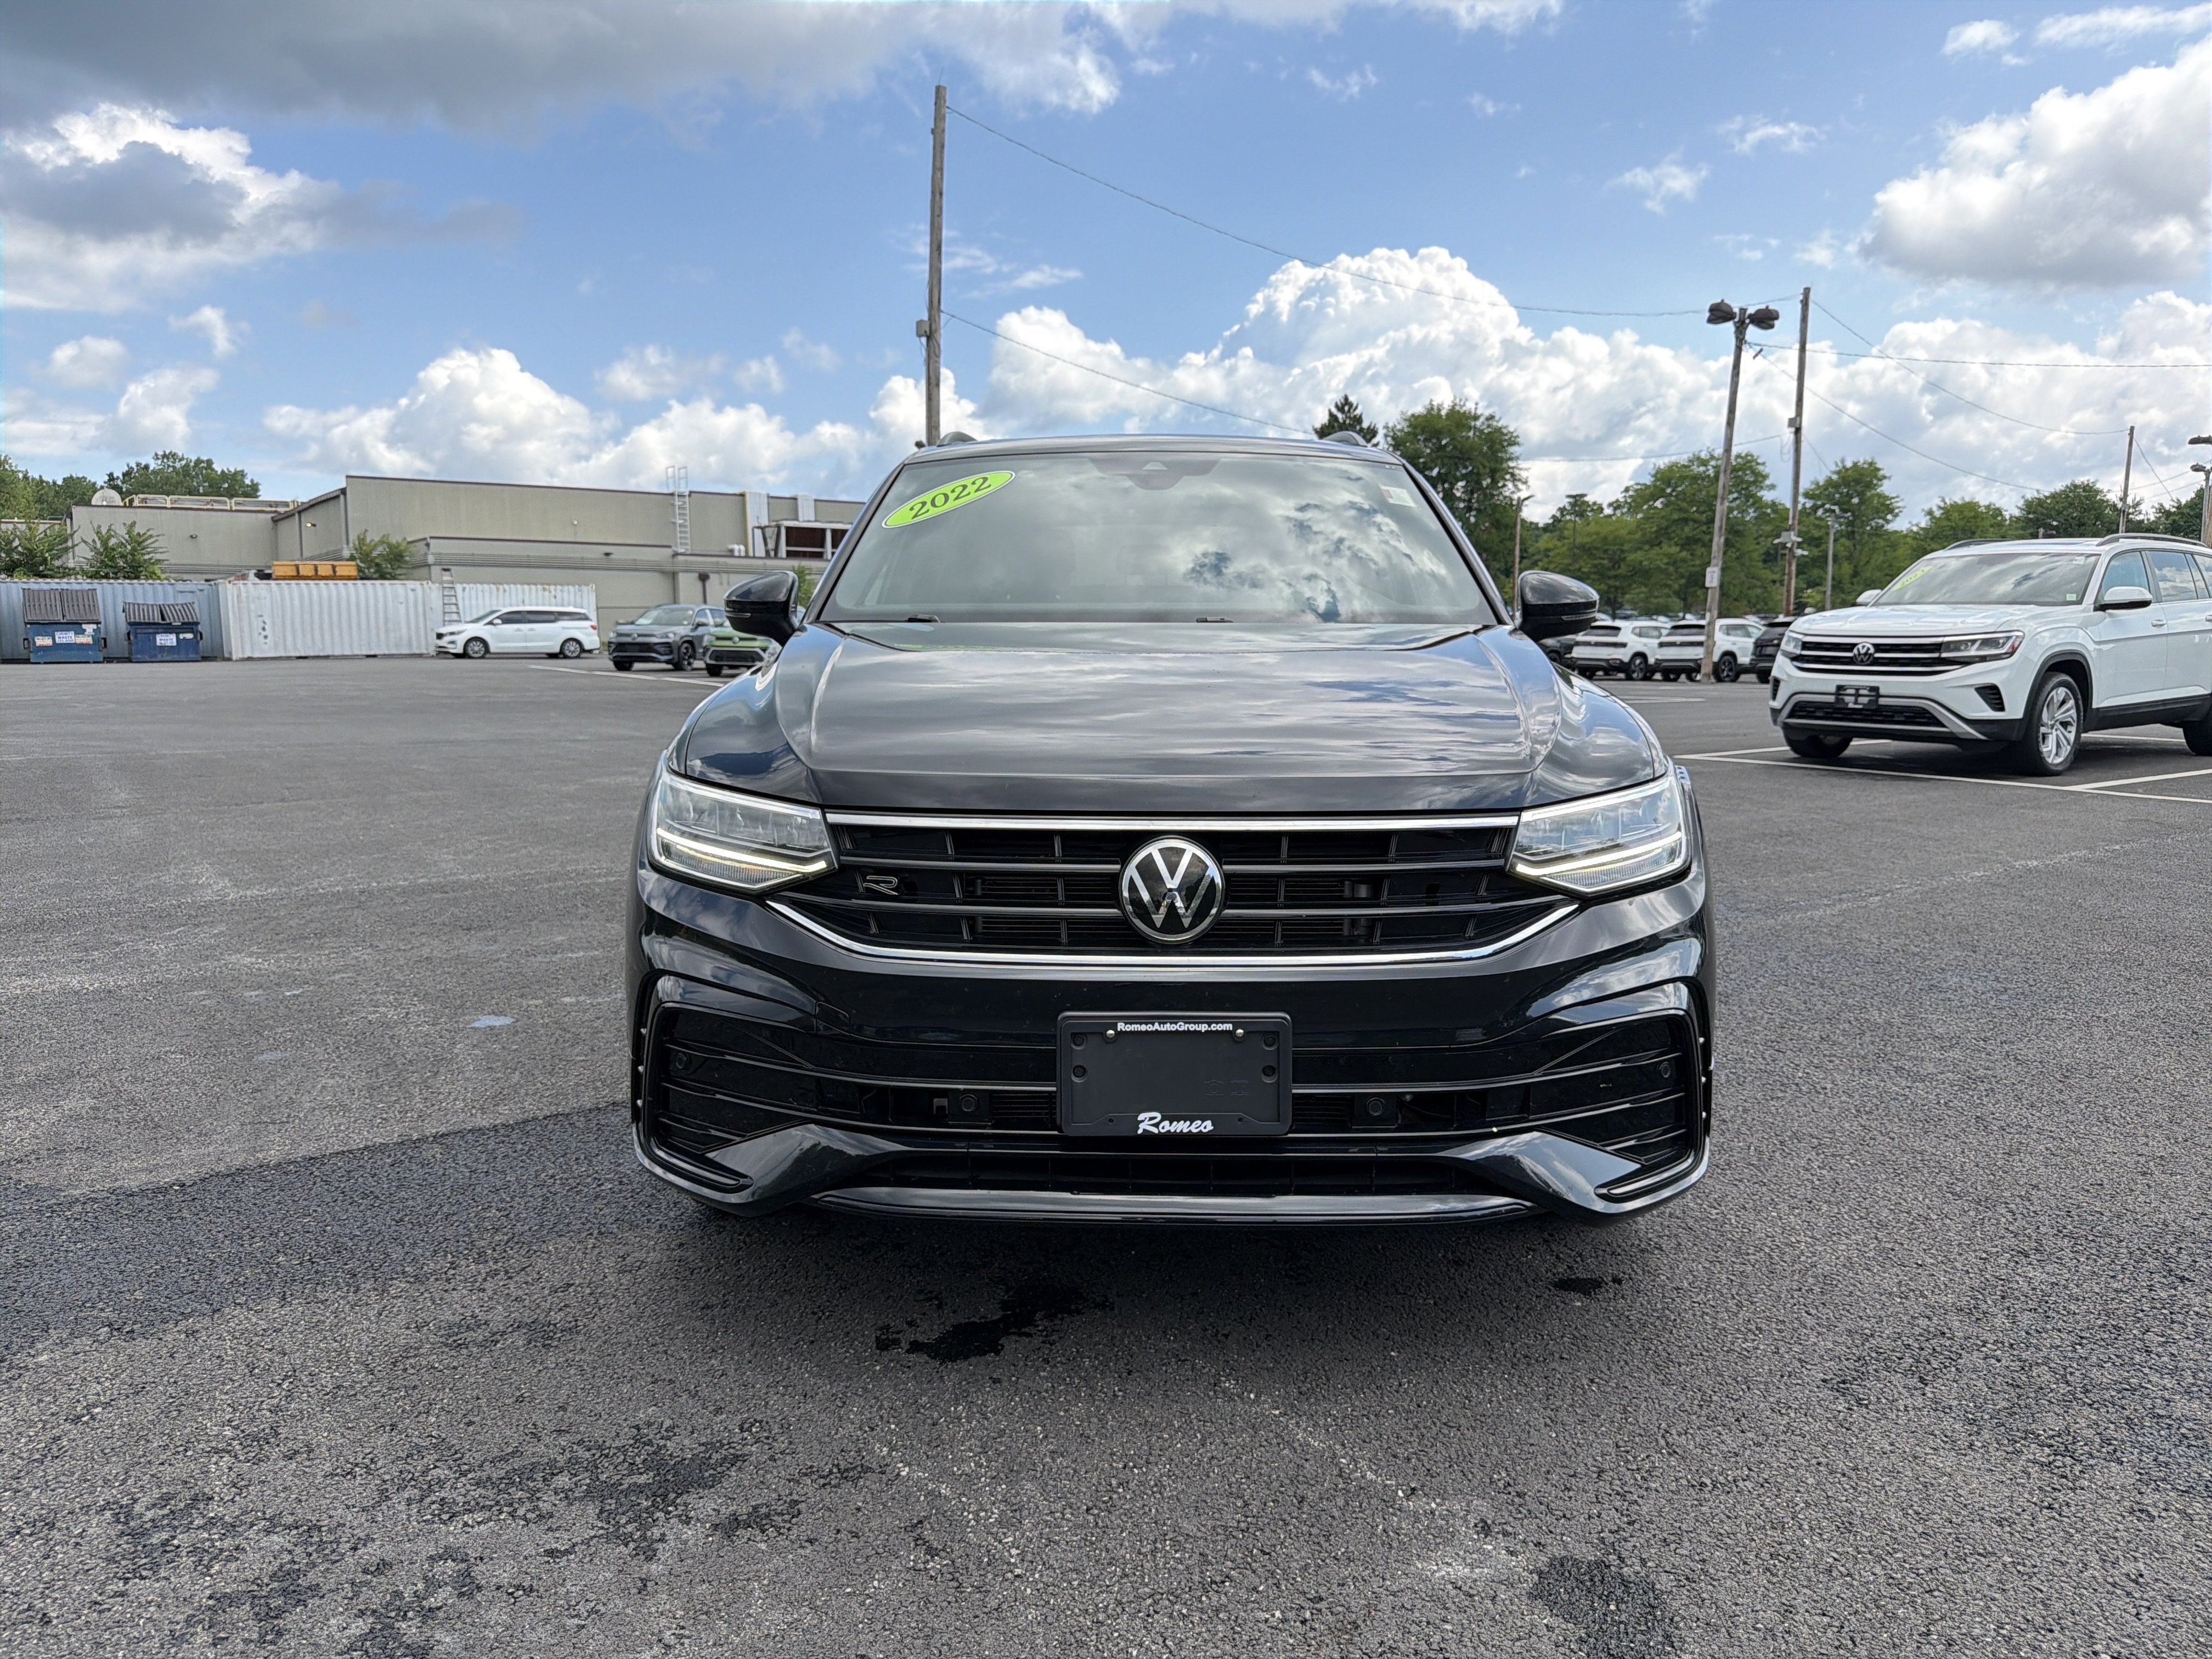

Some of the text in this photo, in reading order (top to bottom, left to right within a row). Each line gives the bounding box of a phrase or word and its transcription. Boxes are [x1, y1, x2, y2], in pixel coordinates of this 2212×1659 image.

[909, 476, 992, 520] 2022
[863, 875, 899, 895] R
[1122, 838, 1222, 941] VW
[1117, 1022, 1233, 1032] RomeoAutoGroup.com
[1137, 1111, 1214, 1134] Romeo
